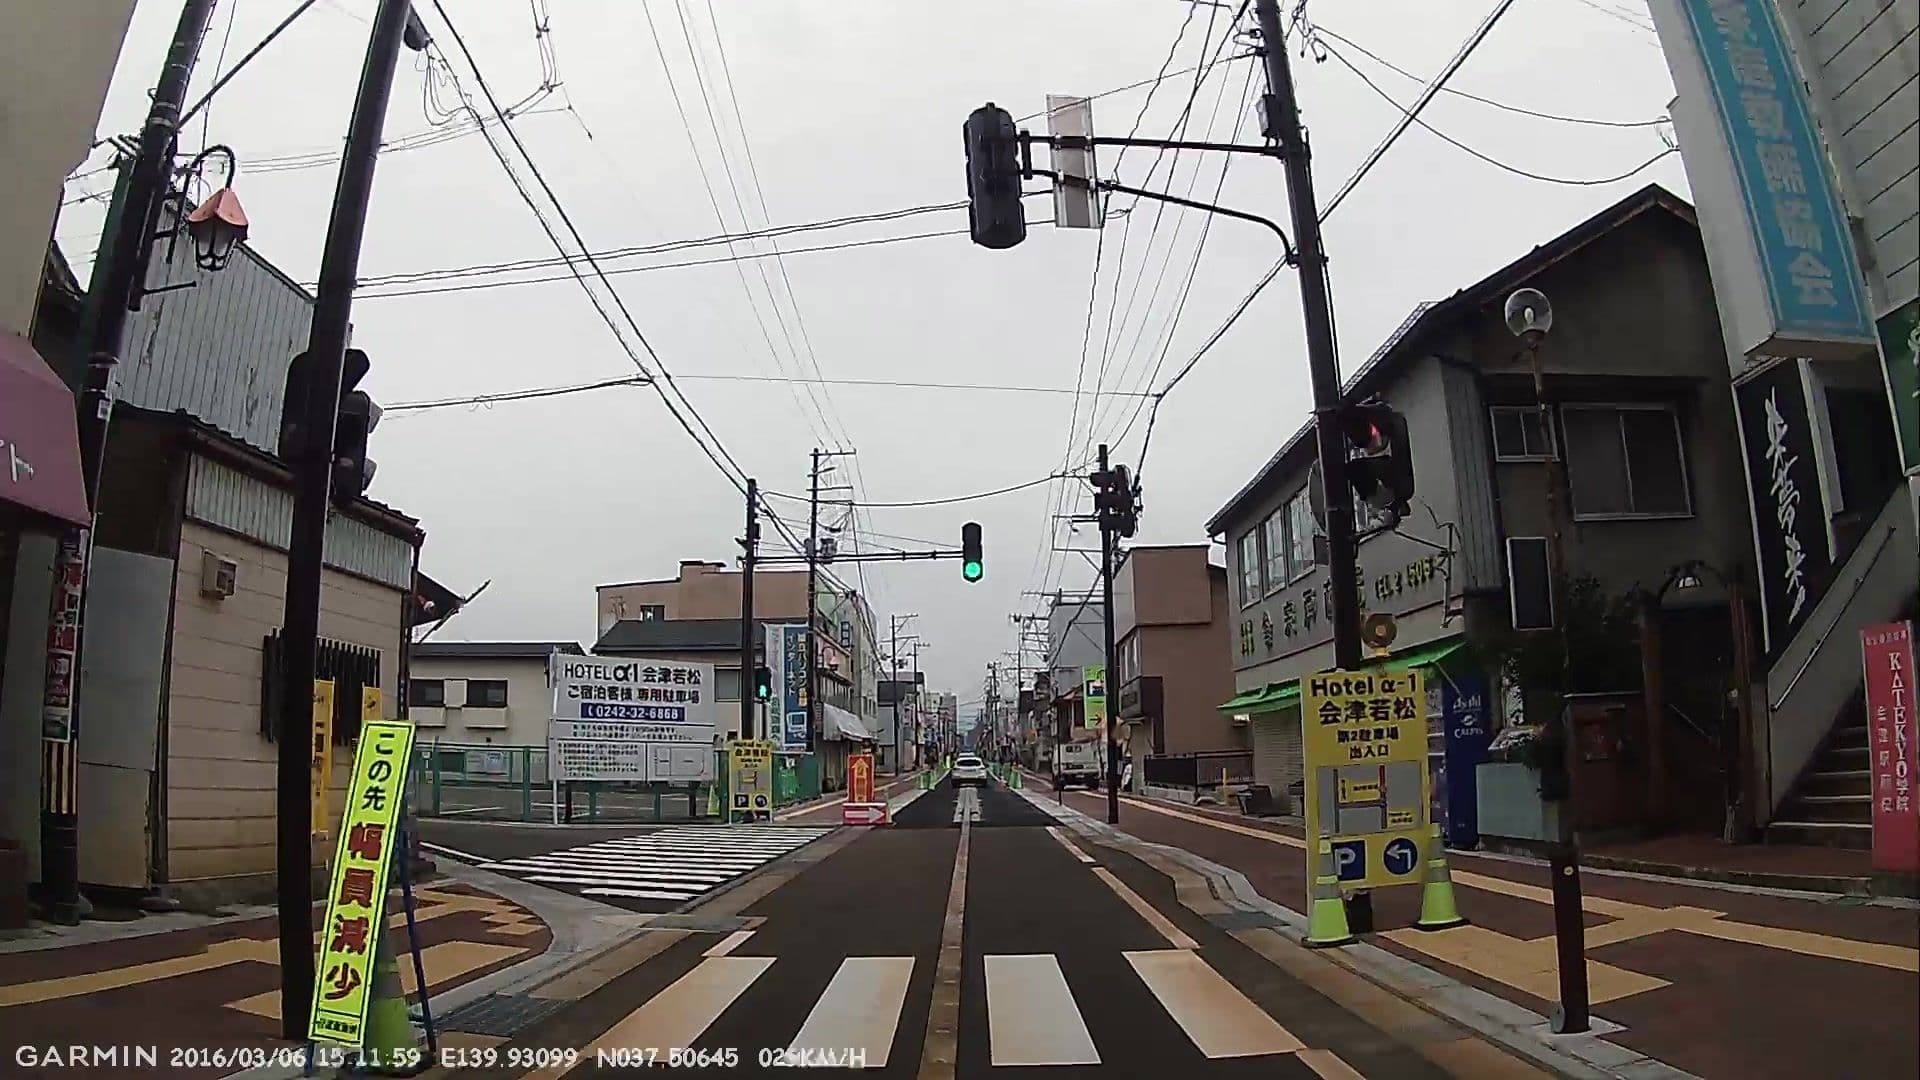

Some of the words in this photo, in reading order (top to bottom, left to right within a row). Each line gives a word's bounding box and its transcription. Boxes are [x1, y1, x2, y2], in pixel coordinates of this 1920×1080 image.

[642, 666, 702, 685] 会津若松
[1310, 676, 1374, 697] Hotel
[1318, 697, 1417, 725] 会津若松
[1349, 744, 1390, 760] 出入口
